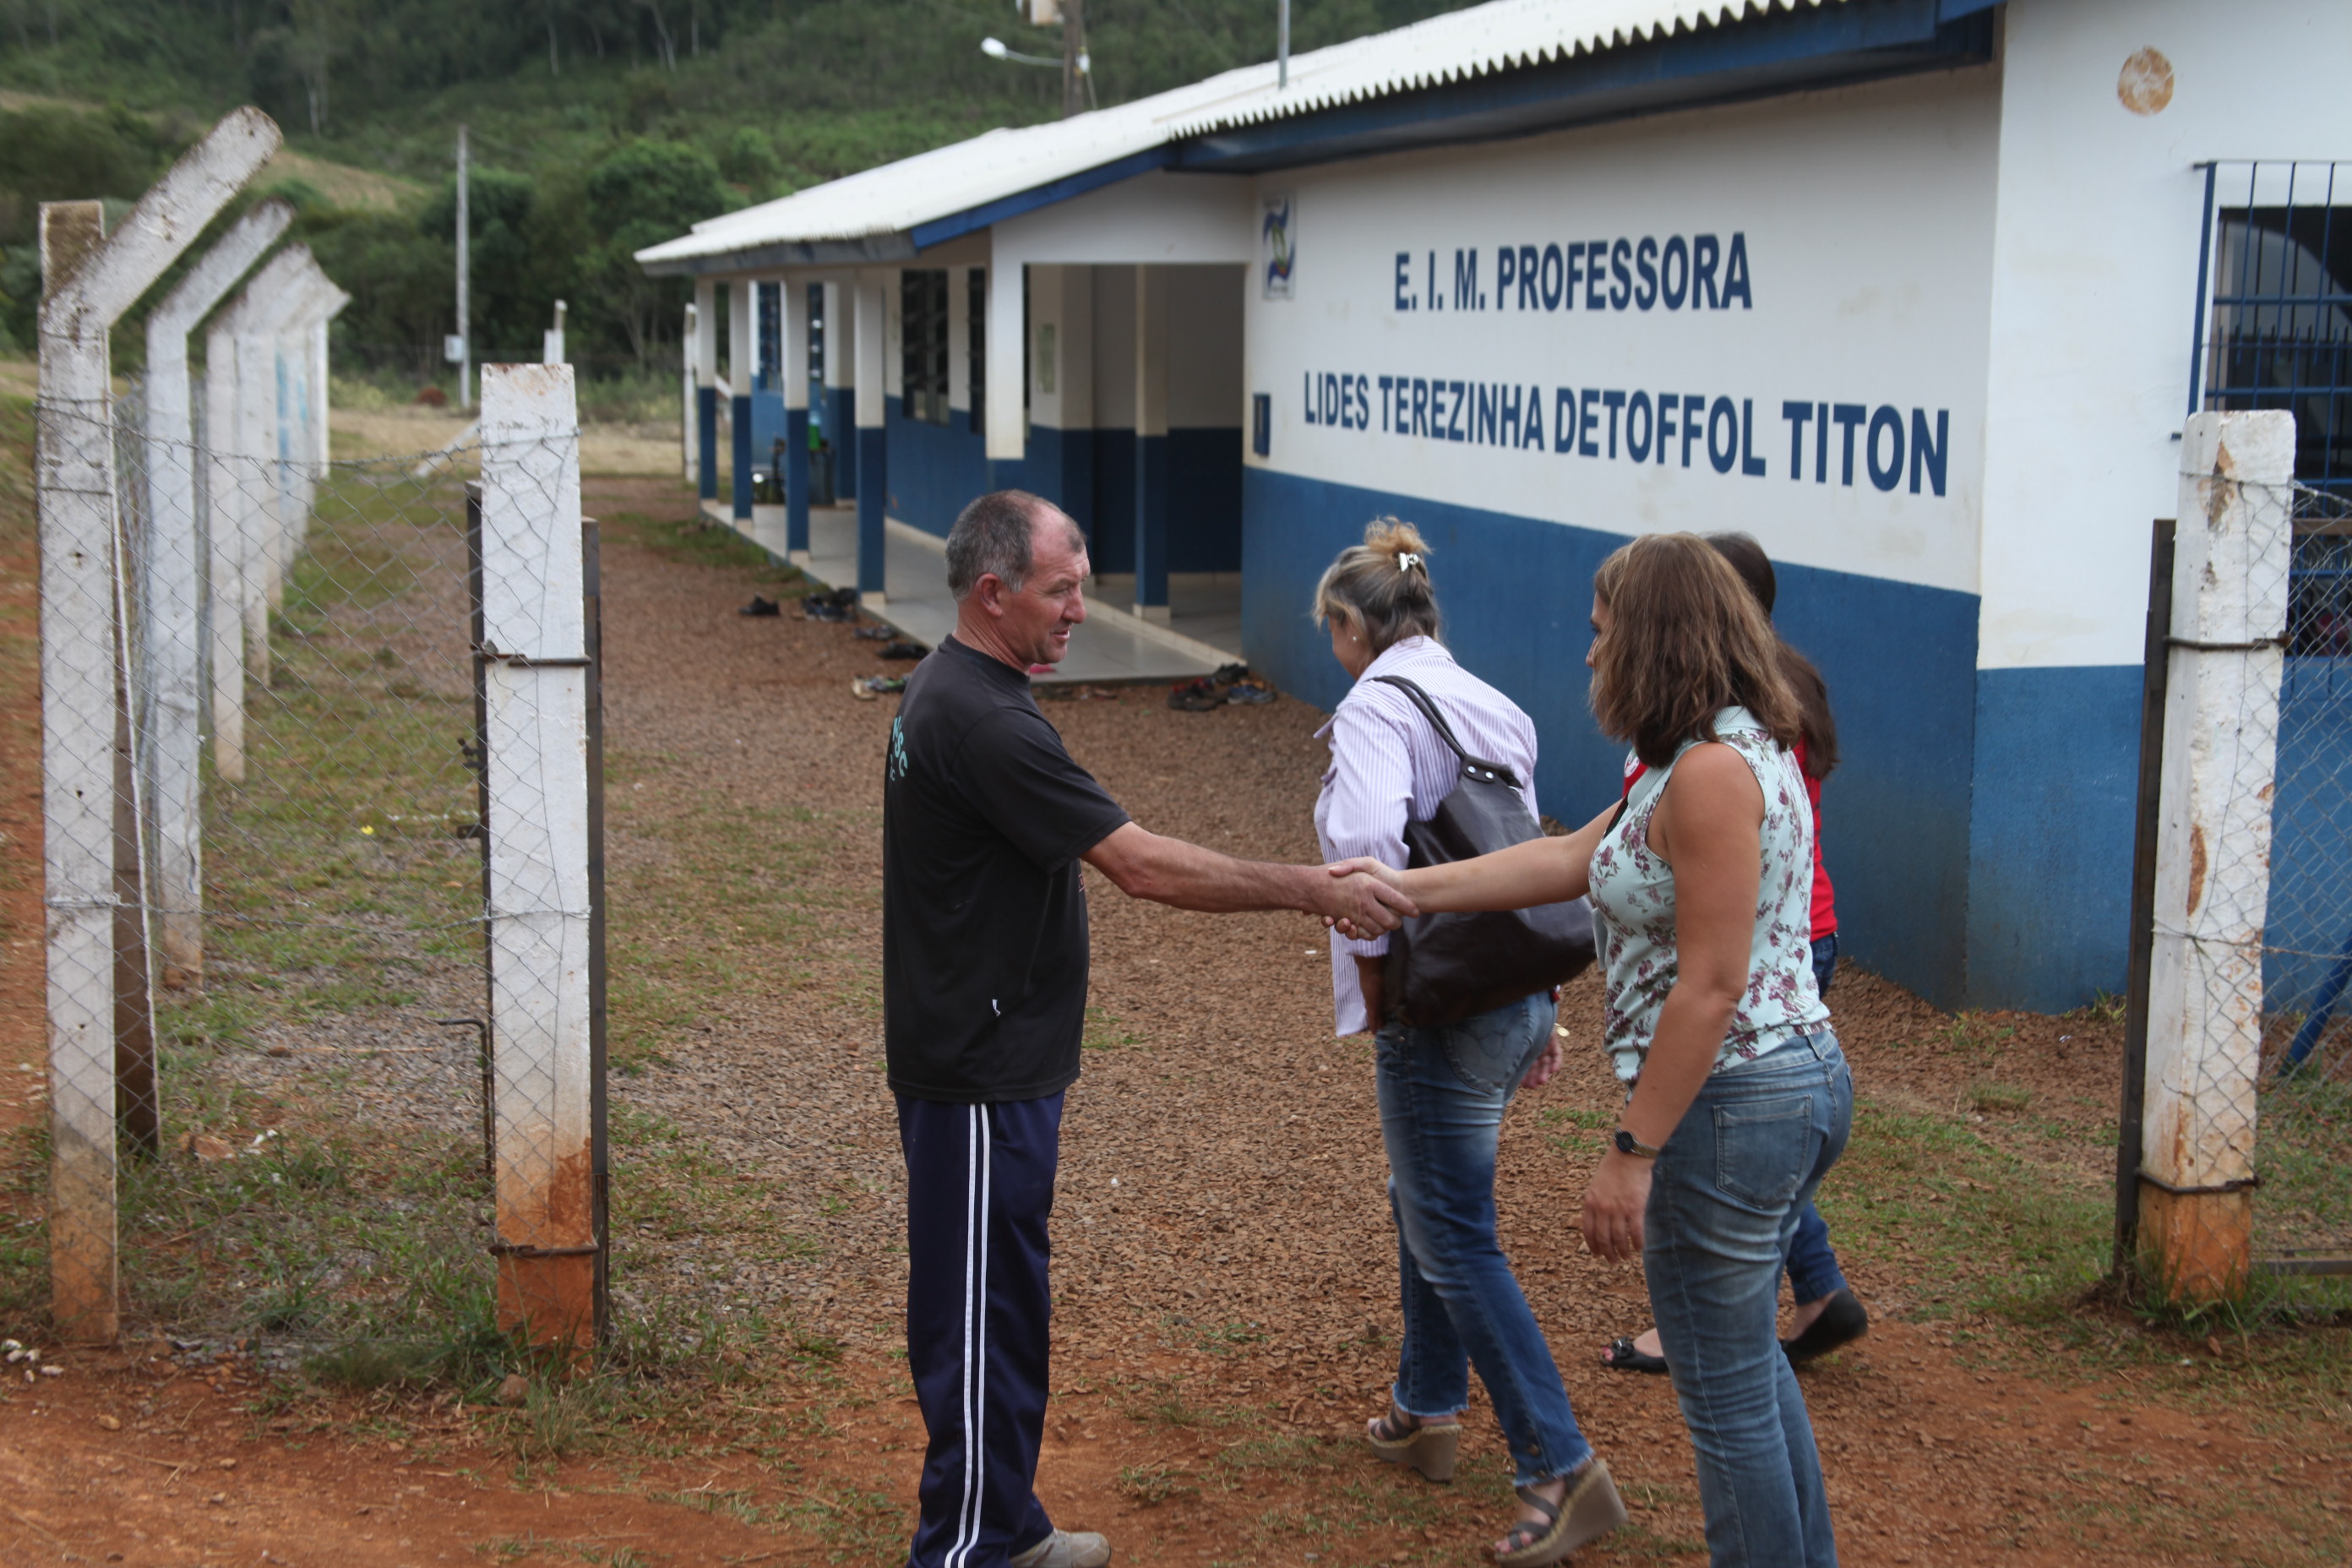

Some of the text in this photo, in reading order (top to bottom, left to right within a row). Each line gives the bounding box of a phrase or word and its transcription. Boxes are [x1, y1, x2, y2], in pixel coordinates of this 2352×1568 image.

[1497, 231, 1753, 312] PROFESSORA
[1304, 371, 1950, 497] LIDES TEREZINHA DETOFFOL TITON
